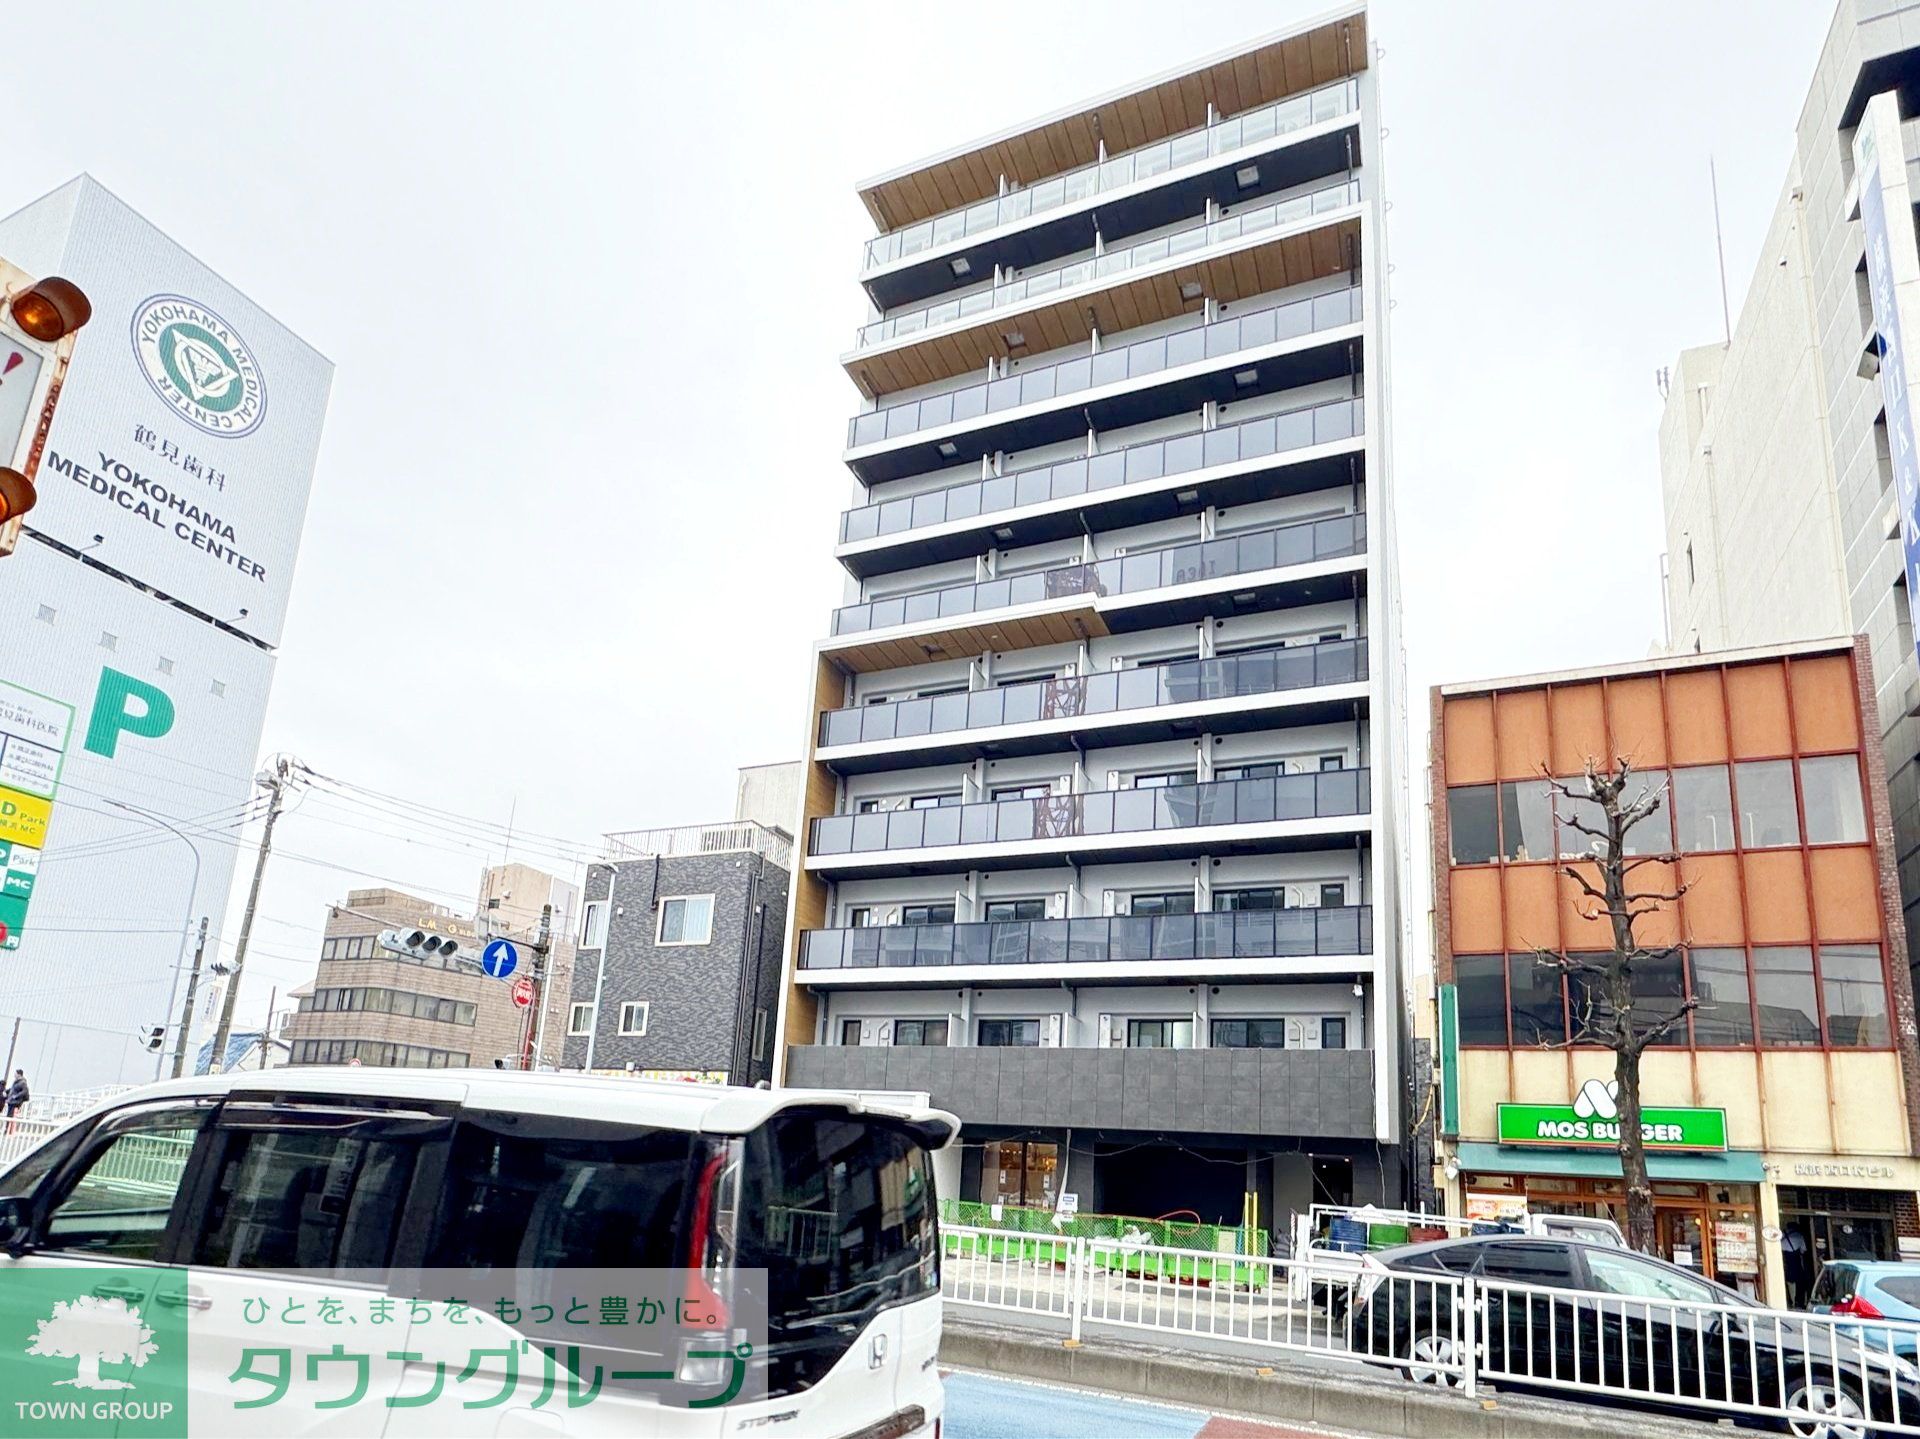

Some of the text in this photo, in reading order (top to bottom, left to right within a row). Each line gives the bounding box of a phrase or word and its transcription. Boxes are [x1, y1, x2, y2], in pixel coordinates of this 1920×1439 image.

[142, 304, 258, 428] YOKOHAMA MEDICAL CENTER
[134, 423, 226, 492] 鶴見歯科
[47, 450, 266, 583] MEDICAL CENTER
[98, 451, 236, 544] YOKOHAMA
[84, 666, 175, 759] P
[20, 812, 46, 827] Park
[6, 876, 31, 891] MC
[12, 854, 36, 867] Park
[1537, 1121, 1683, 1142] MOS BUGER
